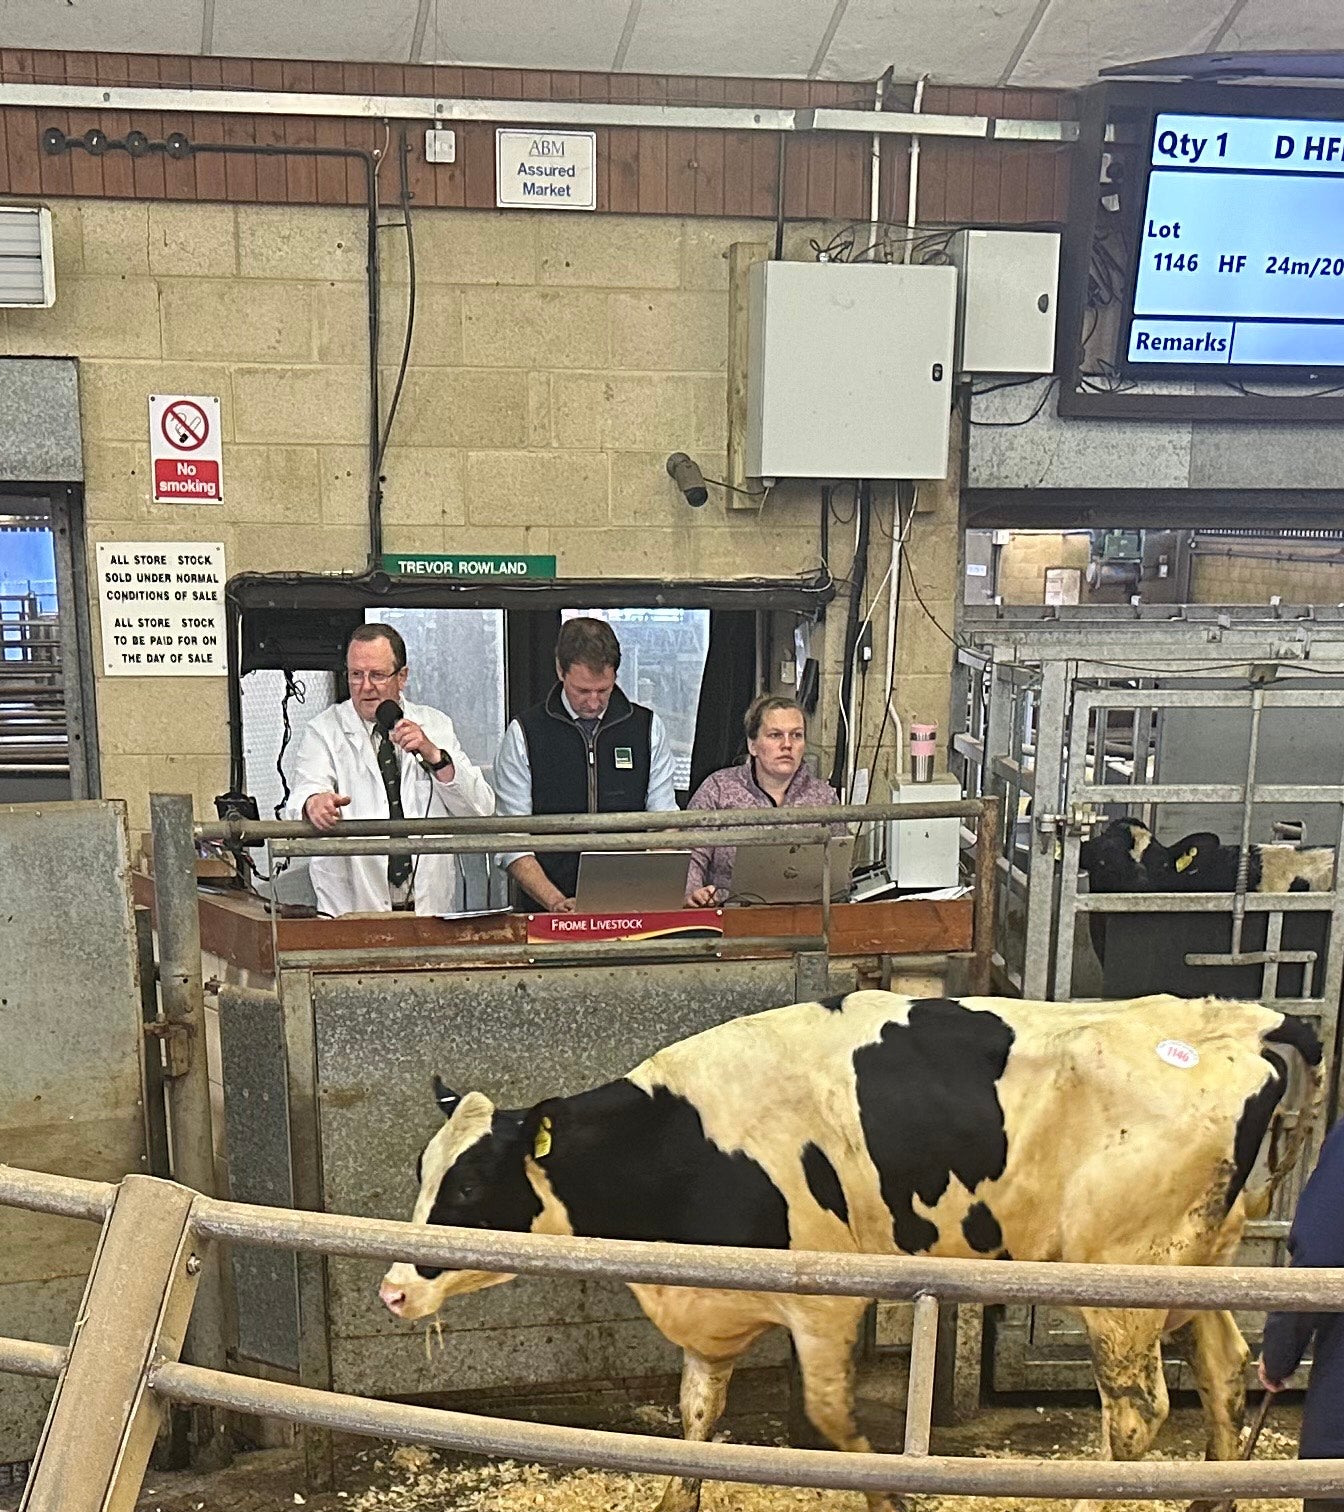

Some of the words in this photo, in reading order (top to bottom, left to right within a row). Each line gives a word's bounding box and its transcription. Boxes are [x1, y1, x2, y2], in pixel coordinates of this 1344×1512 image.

[528, 140, 565, 156] ABM
[1158, 130, 1207, 163] Qty
[1216, 133, 1229, 157] 1
[1274, 136, 1295, 159] D
[517, 162, 576, 177] Assured
[523, 182, 571, 197] Market
[1147, 220, 1181, 238] Lot
[1153, 253, 1198, 271] 1146
[1218, 255, 1247, 273] HF
[1136, 332, 1227, 351] Remarks
[177, 462, 197, 476] No
[159, 479, 216, 496] smoking
[110, 555, 129, 565] ALL
[134, 555, 167, 565] STORE
[178, 555, 213, 565] STOCK
[398, 561, 453, 574] TREVOR
[459, 562, 527, 575] ROWLAND
[105, 572, 132, 583] SOLD
[136, 573, 171, 583] UNDER
[176, 573, 219, 583] NORMAL
[106, 591, 170, 601] CONDITIONS
[174, 591, 187, 601] OF
[192, 591, 218, 601] SALE
[114, 618, 133, 628] ALL
[138, 618, 171, 628] STORE
[181, 618, 215, 628] STOCK
[114, 636, 127, 645] TO
[132, 636, 145, 646] BE
[150, 636, 173, 645] PAID
[178, 636, 197, 645] FOR
[202, 636, 217, 645] ON
[122, 654, 141, 663] THE
[146, 654, 165, 663] DAY
[170, 654, 183, 663] OF
[188, 654, 213, 663] SALE
[552, 919, 587, 931] FROME
[590, 918, 643, 930] LIVESTOCK
